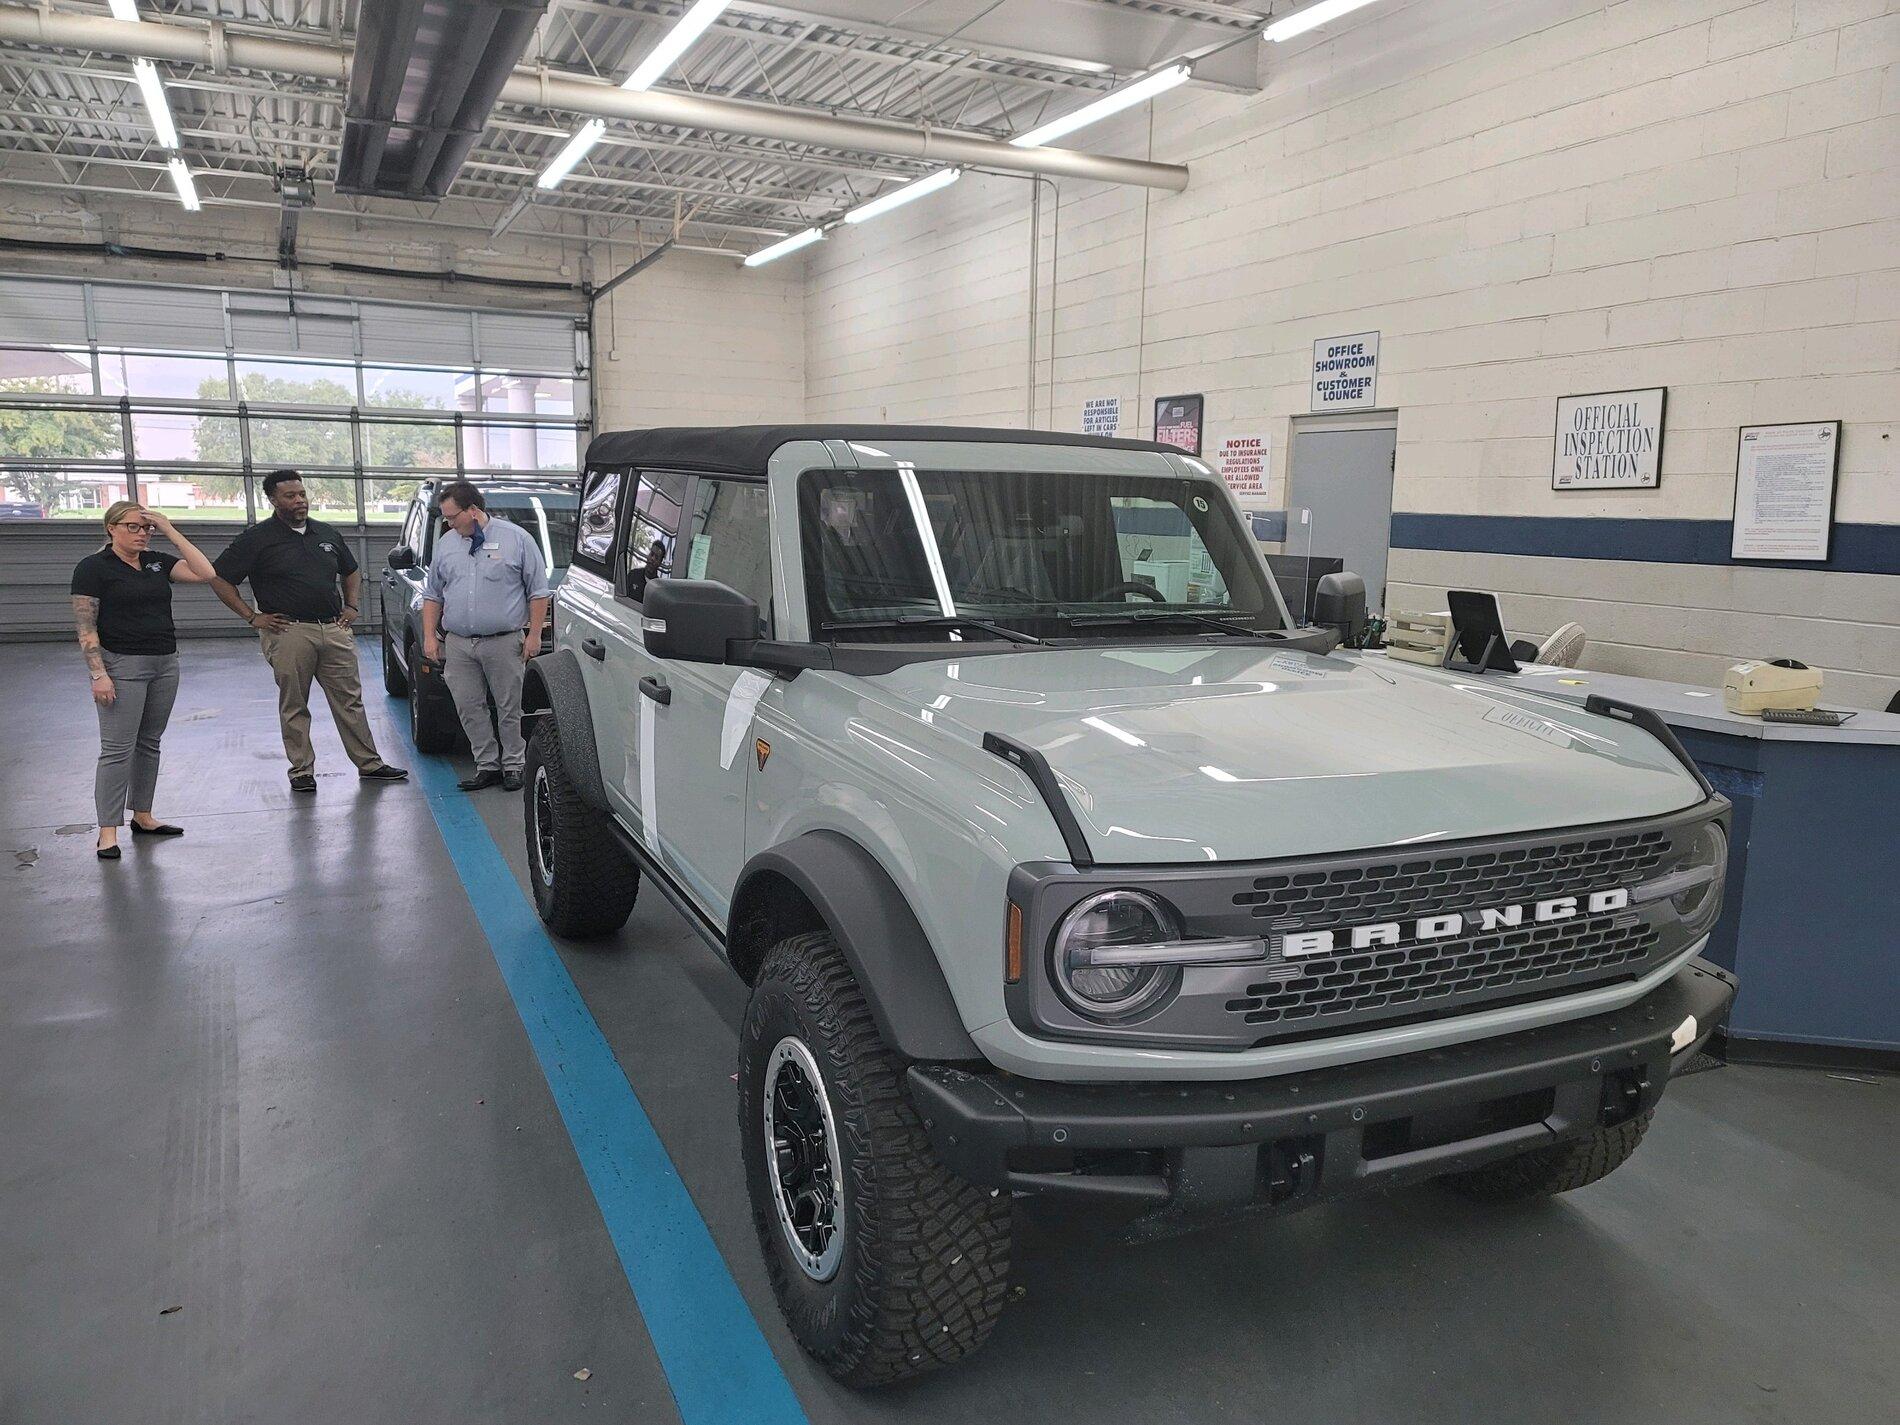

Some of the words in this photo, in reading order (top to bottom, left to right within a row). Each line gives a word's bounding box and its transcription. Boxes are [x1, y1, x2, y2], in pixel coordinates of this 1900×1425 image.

[1328, 343, 1363, 358] OFFICE
[1315, 355, 1375, 373] SHOWROOM
[1316, 377, 1372, 391] CUSTOMER
[1323, 388, 1363, 402] LOUNGE
[1095, 400, 1105, 408] ARE
[1083, 407, 1118, 417] RESPONSIBLE
[1574, 402, 1641, 431] OFFICIAL
[1083, 417, 1094, 425] FOR
[1095, 415, 1118, 424] ARTICLES
[1103, 423, 1117, 431] CARS
[1157, 428, 1199, 443] FILTERS
[1563, 427, 1654, 456] INSPECTION
[1226, 439, 1262, 448] NOTICE
[1238, 449, 1268, 457] INSURANCE
[1225, 458, 1261, 466] REGULATIONS
[1574, 453, 1639, 480] STATION
[1282, 887, 1628, 957] BRONCO
